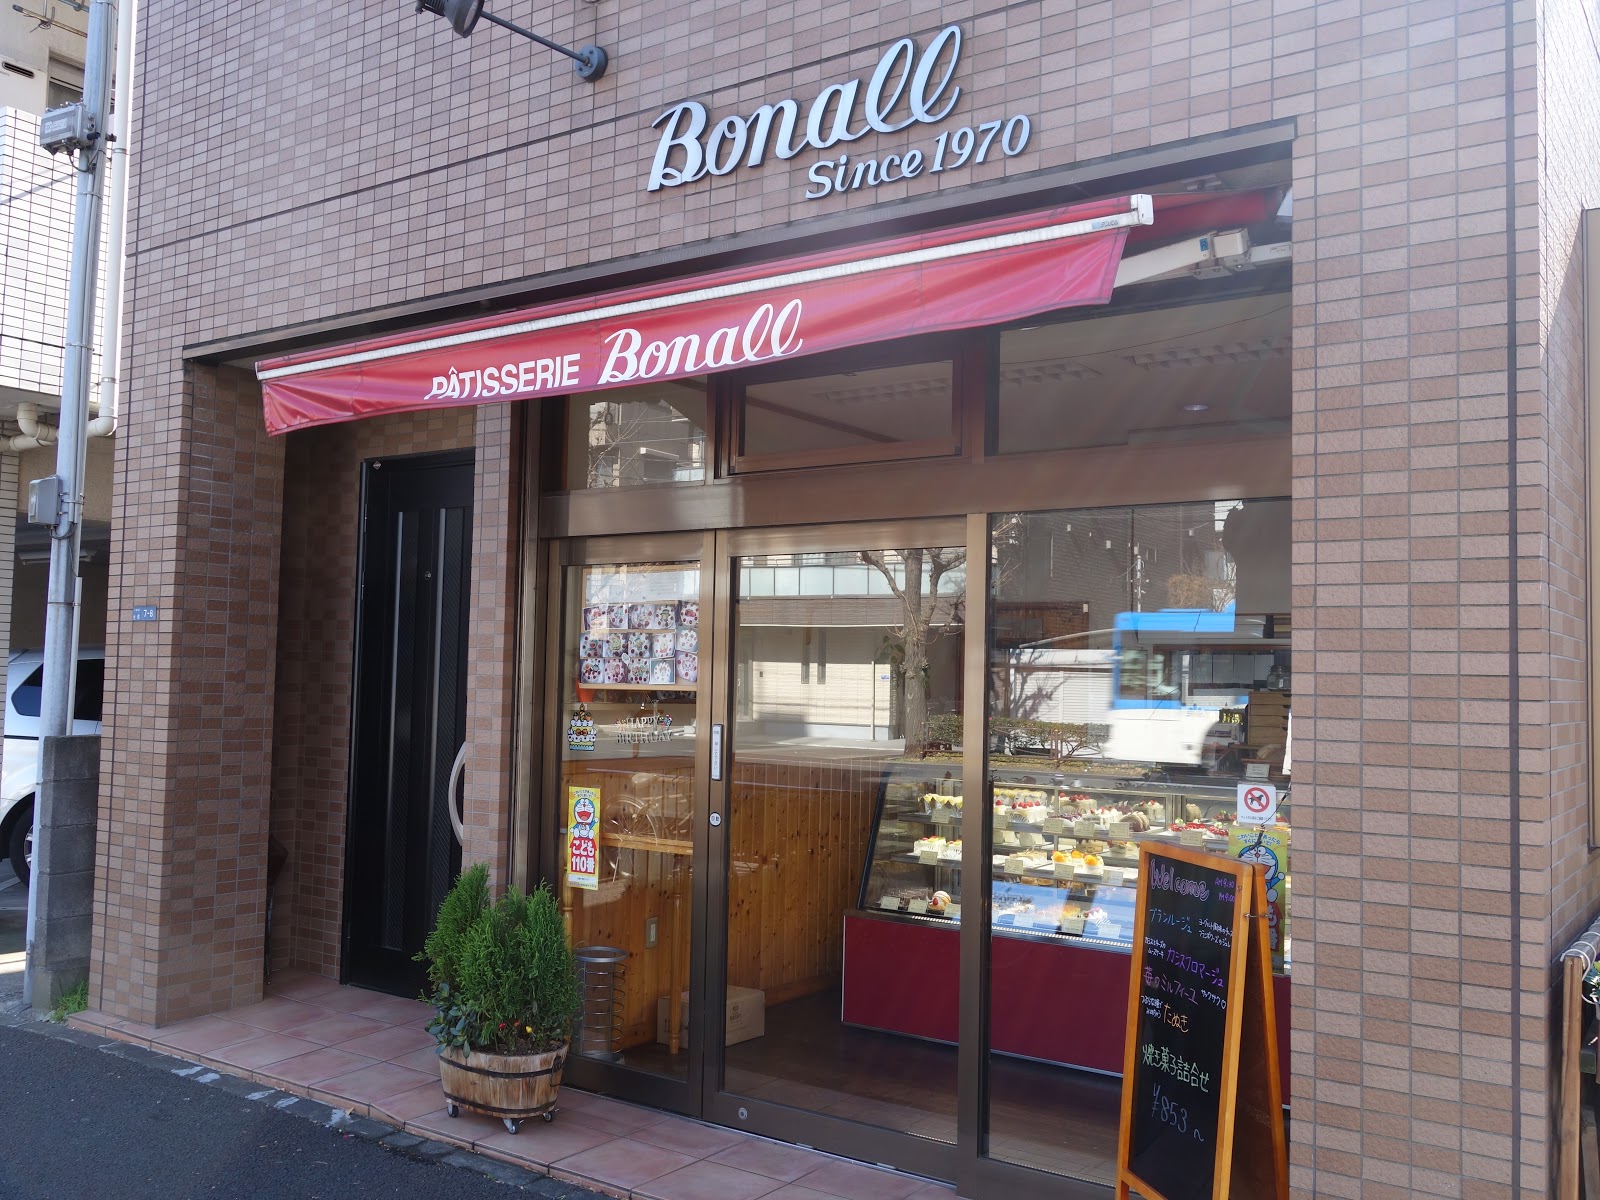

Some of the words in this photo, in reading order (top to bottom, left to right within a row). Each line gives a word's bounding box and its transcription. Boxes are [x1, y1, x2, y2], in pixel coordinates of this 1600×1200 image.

[646, 25, 962, 192] Bonall
[805, 149, 925, 200] Since
[928, 114, 1032, 174] 1970
[424, 353, 581, 401] PÂTISSERIE
[597, 298, 803, 385] Bonall
[143, 609, 154, 618] 7-8
[626, 714, 660, 729] HAPPY
[616, 730, 673, 744] BIRTHDAY
[572, 839, 595, 857] こども
[1237, 832, 1281, 845] こわいことあったら
[571, 855, 595, 874] 110番
[1150, 858, 1210, 902] Welcome
[1149, 908, 1193, 934] ブランルージュ
[1166, 947, 1224, 987] カシスフロマージュ
[1162, 1002, 1190, 1033] たぬき
[1142, 1043, 1210, 1093] 焼き菓子詰合せ
